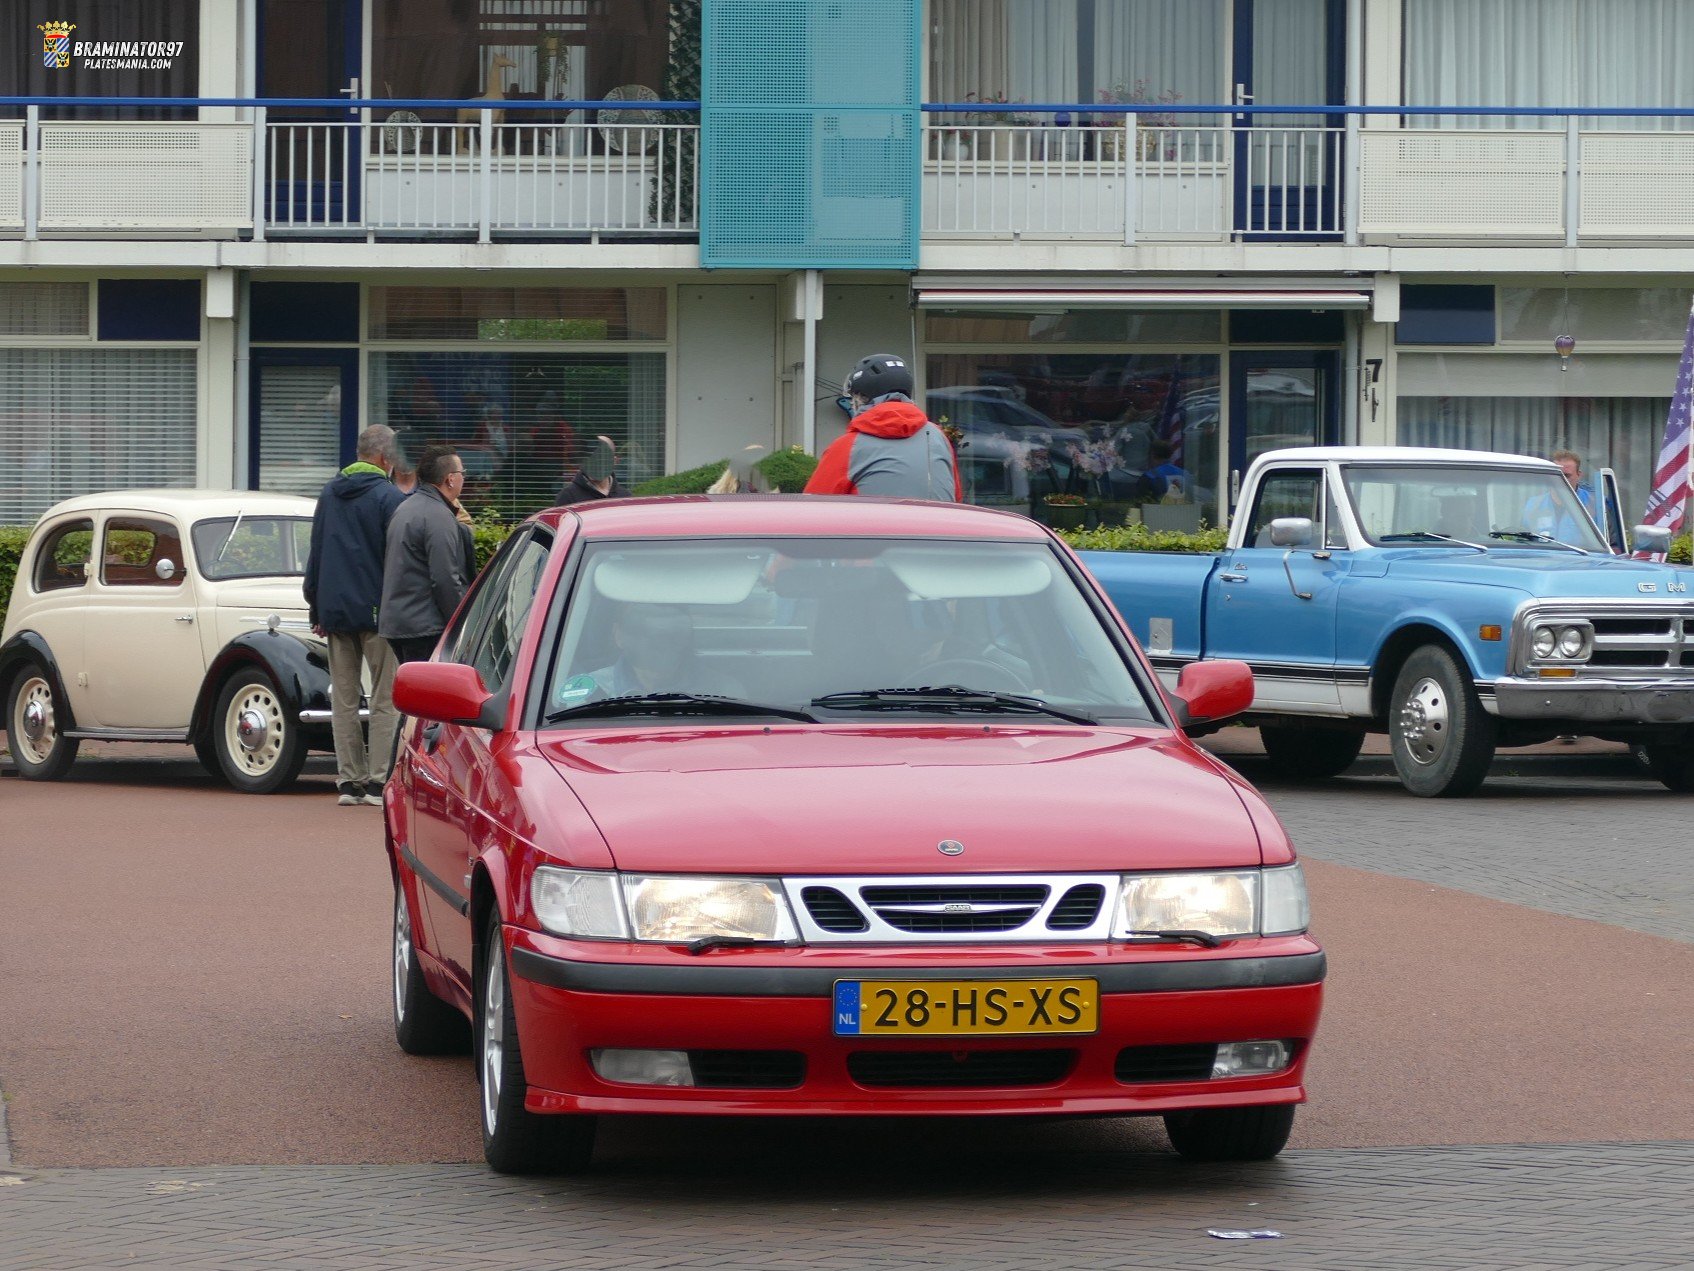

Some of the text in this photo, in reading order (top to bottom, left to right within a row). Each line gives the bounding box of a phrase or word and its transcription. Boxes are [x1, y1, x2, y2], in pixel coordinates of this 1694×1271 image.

[1365, 358, 1383, 383] 7
[838, 1013, 856, 1025] NL
[874, 985, 1082, 1028] 28-HS-XS
